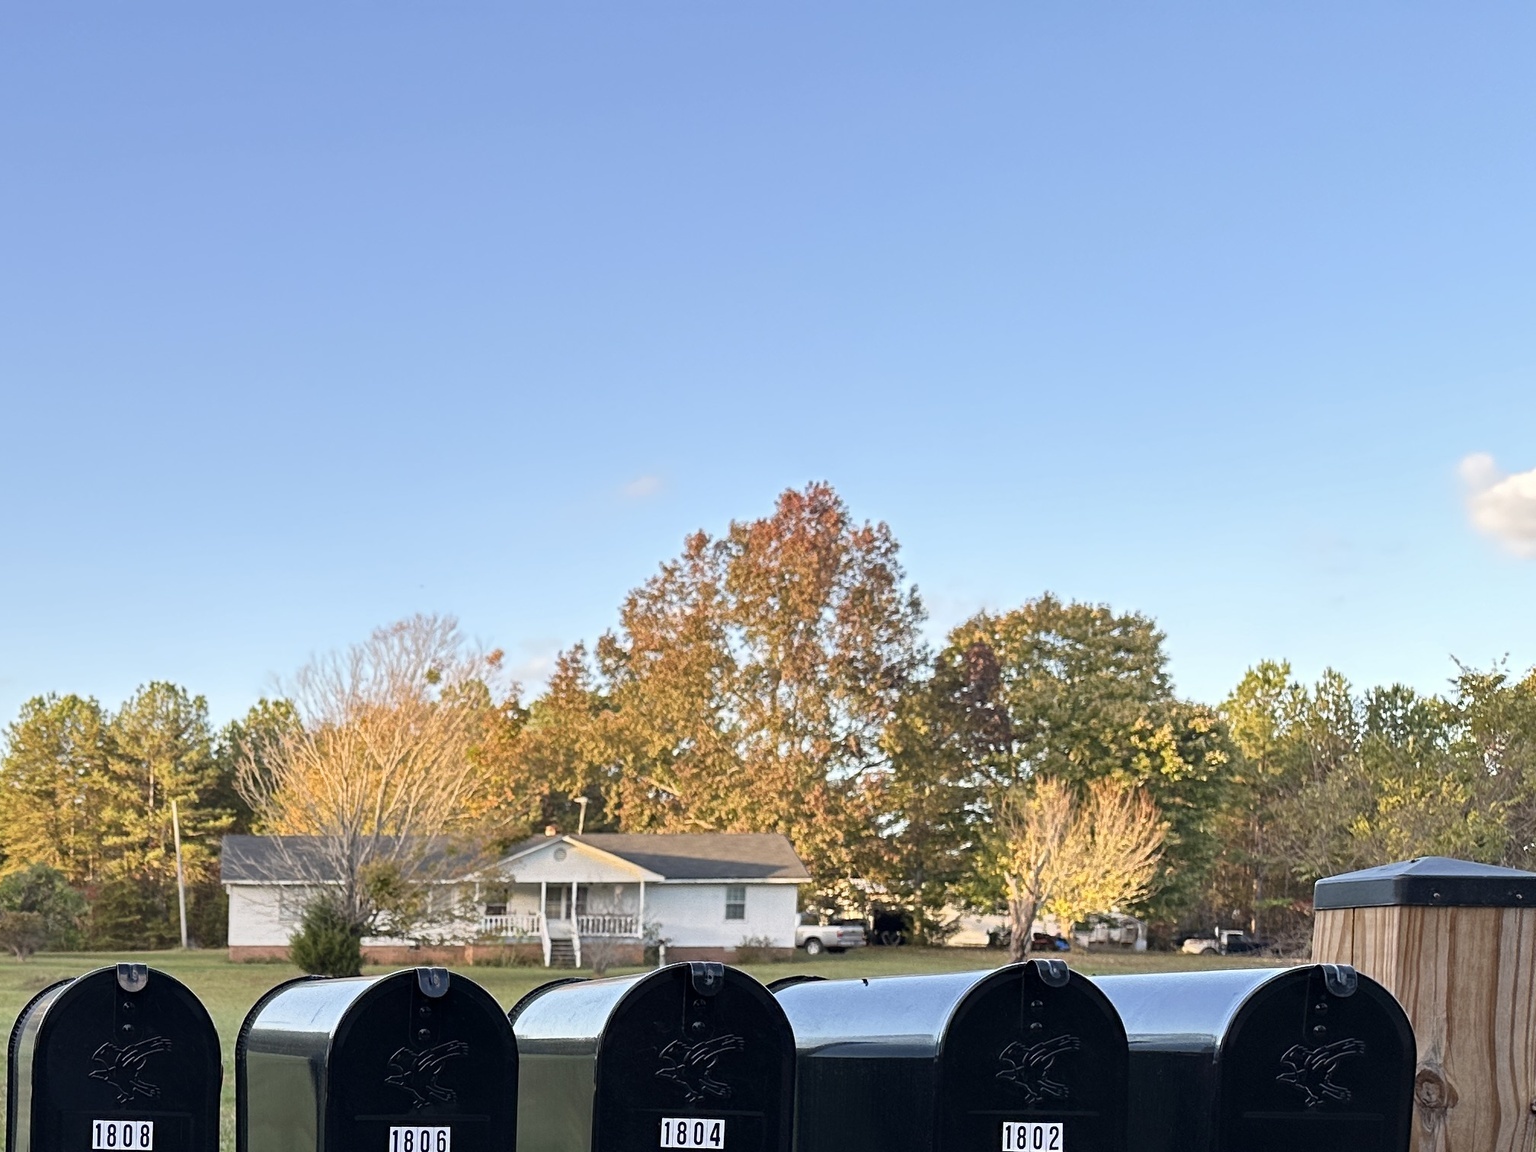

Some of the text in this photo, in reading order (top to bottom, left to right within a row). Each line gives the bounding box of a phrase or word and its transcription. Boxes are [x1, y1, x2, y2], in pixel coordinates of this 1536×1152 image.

[95, 1123, 150, 1148] 1808
[664, 1121, 721, 1147] 1804
[1005, 1125, 1059, 1150] 1802
